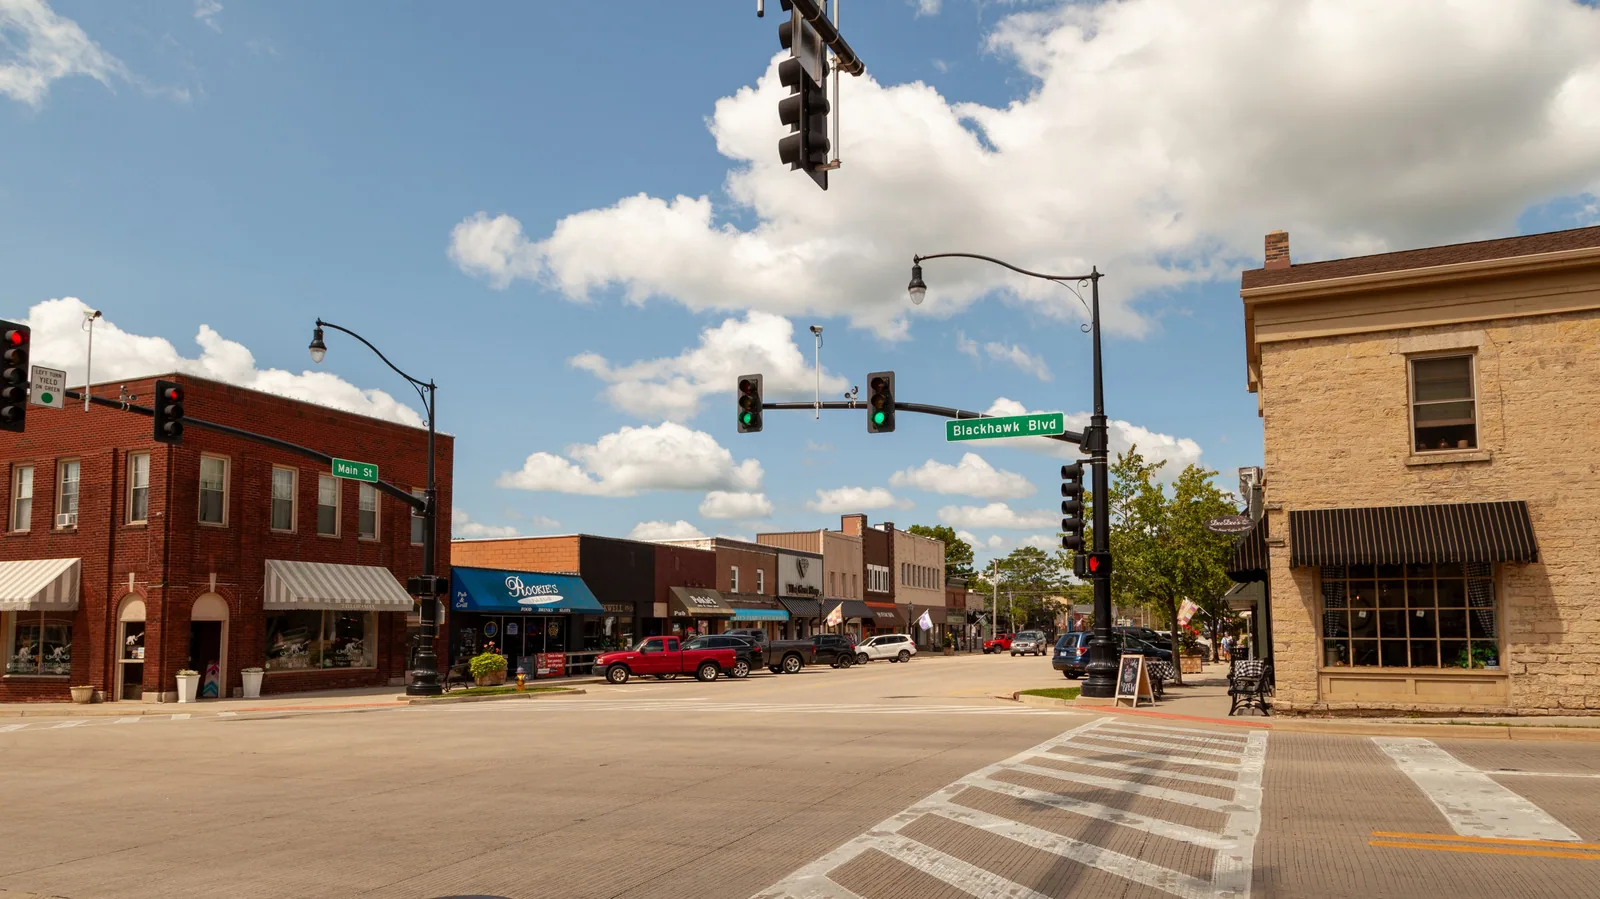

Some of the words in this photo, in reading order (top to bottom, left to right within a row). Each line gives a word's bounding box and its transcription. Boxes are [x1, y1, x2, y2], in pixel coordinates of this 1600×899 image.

[50, 371, 62, 379] TURN
[40, 377, 58, 385] YIELD
[953, 421, 1020, 437] Blackhawk
[1028, 419, 1056, 431] Blvd
[338, 463, 358, 475] Main
[363, 467, 373, 478] St
